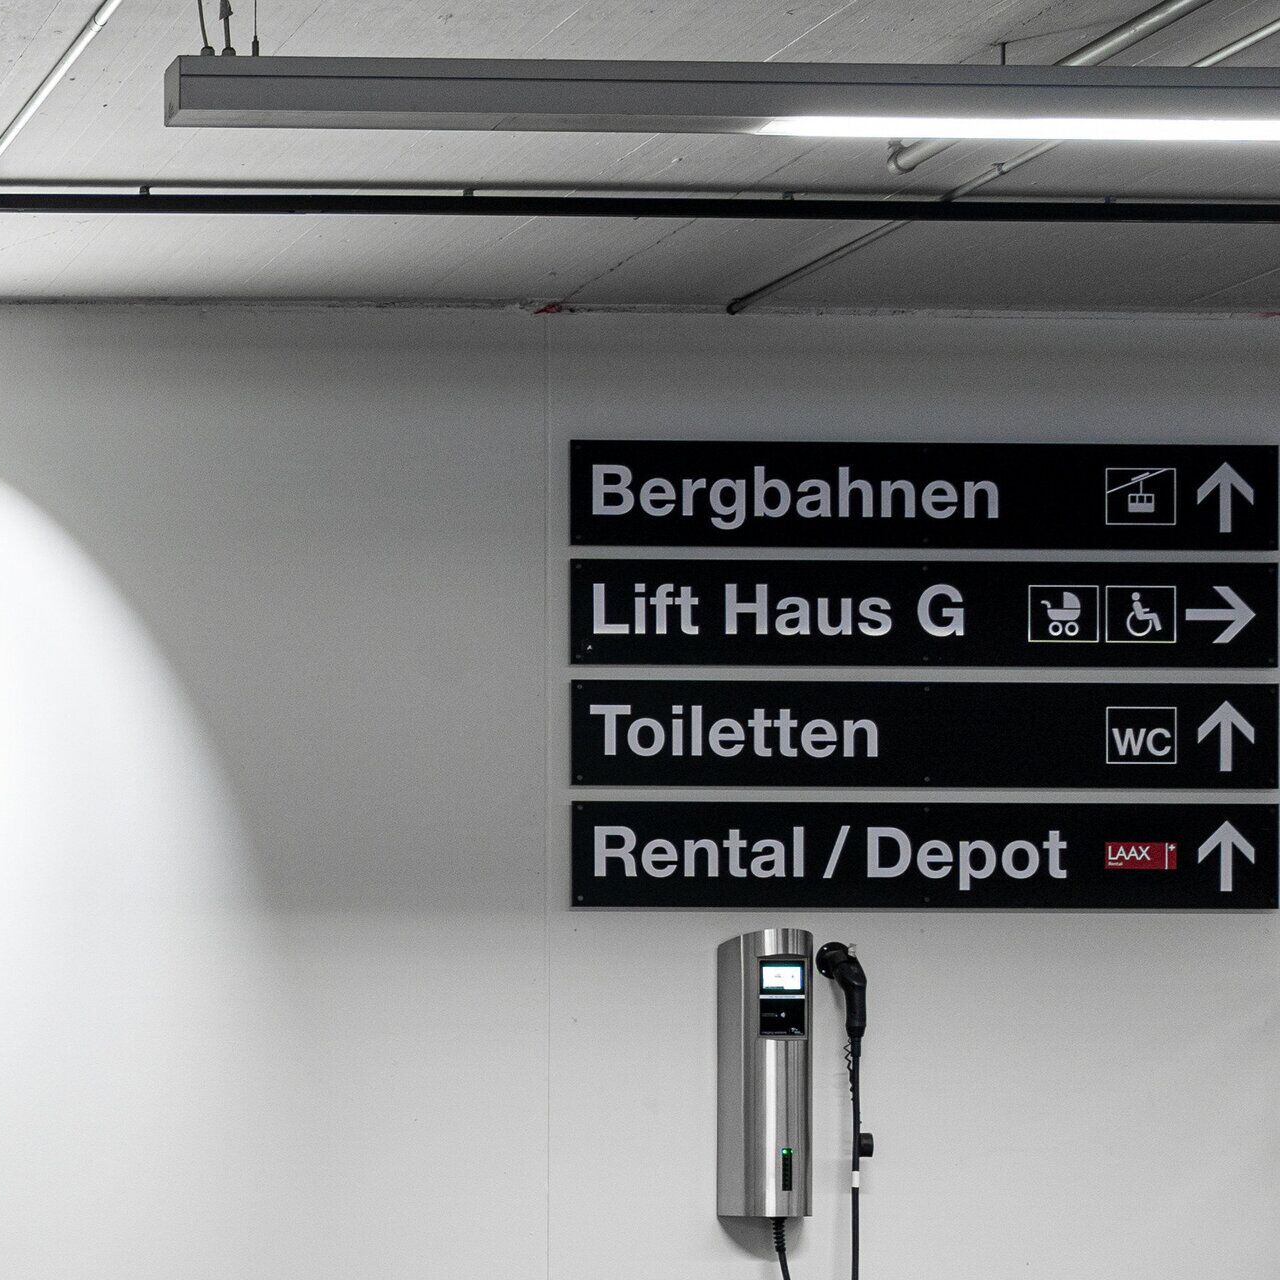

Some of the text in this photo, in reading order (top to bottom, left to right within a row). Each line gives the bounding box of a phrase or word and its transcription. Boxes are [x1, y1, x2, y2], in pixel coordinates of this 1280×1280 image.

[592, 464, 999, 530] Bergbahnen
[592, 582, 965, 638] Lift Haus G
[589, 704, 879, 759] Toiletten
[1111, 727, 1172, 757] WC
[593, 825, 1068, 891] Rental / Depot
[1108, 845, 1151, 861] LAAX
